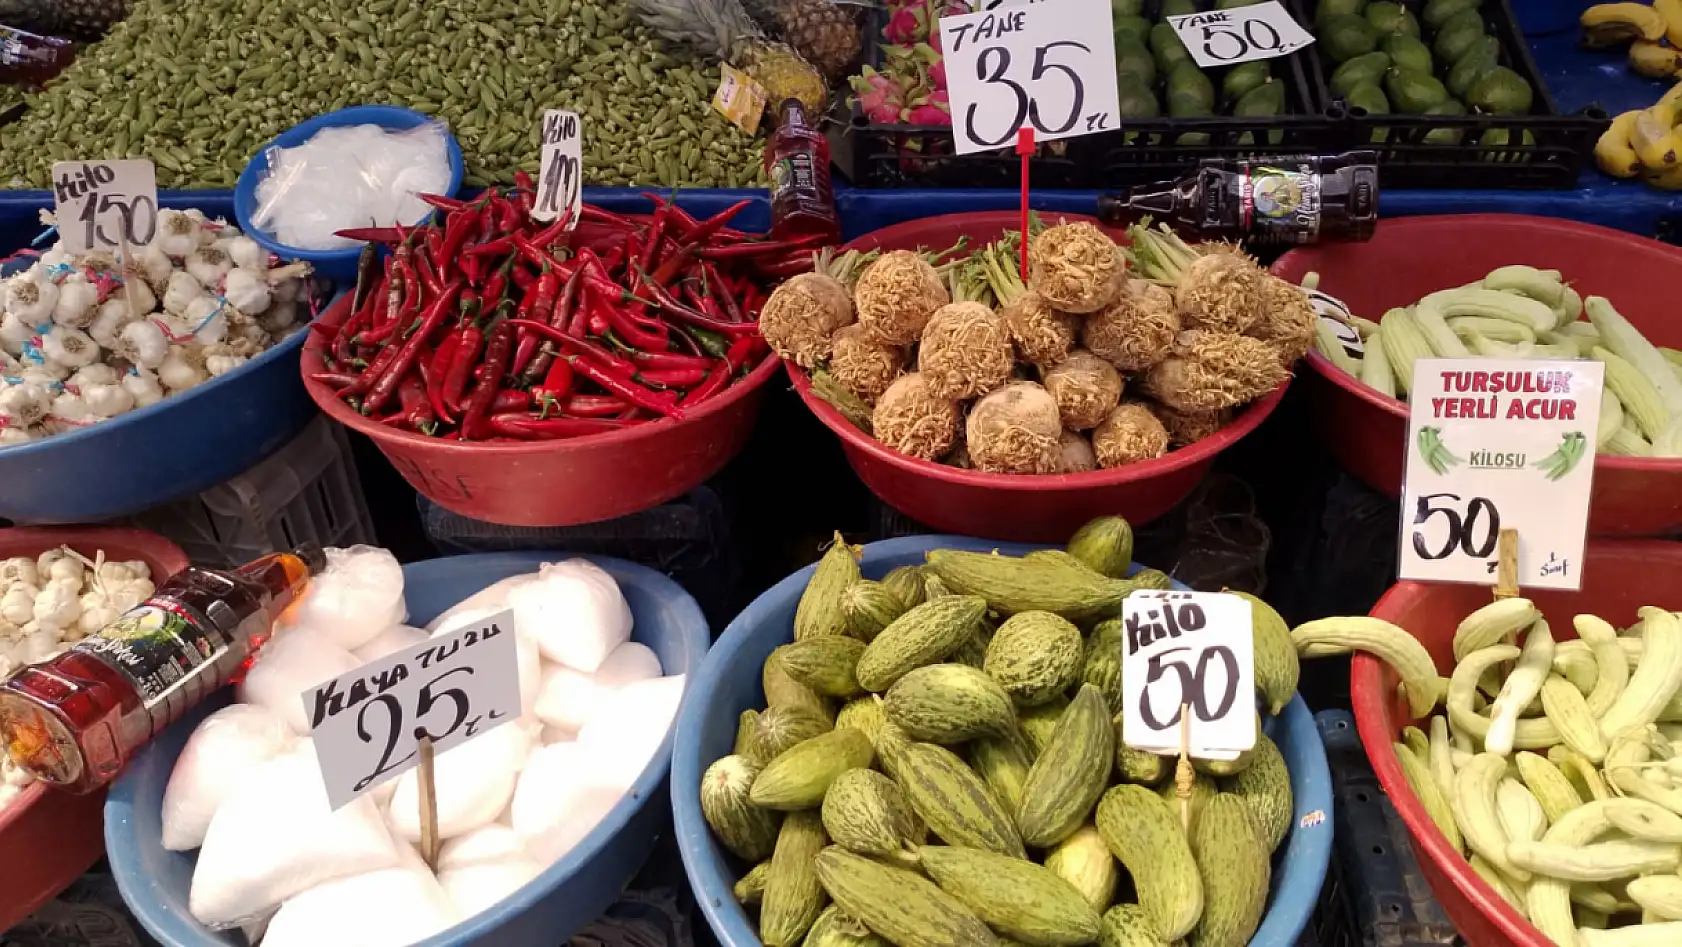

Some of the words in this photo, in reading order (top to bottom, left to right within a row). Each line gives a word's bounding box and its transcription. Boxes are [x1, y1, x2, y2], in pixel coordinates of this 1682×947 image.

[949, 12, 1026, 51] TANE
[1202, 19, 1281, 60] 50
[966, 41, 1091, 145] 35
[79, 192, 156, 249] 150
[1432, 396, 1498, 418] YERLİ
[1506, 399, 1577, 420] ACUR
[1440, 371, 1573, 394] TURŞULUK
[1469, 449, 1526, 469] KİLOSU
[1413, 493, 1500, 560] 50
[312, 663, 410, 730] KAYA
[1139, 645, 1240, 731] 50
[352, 666, 475, 792] 25
